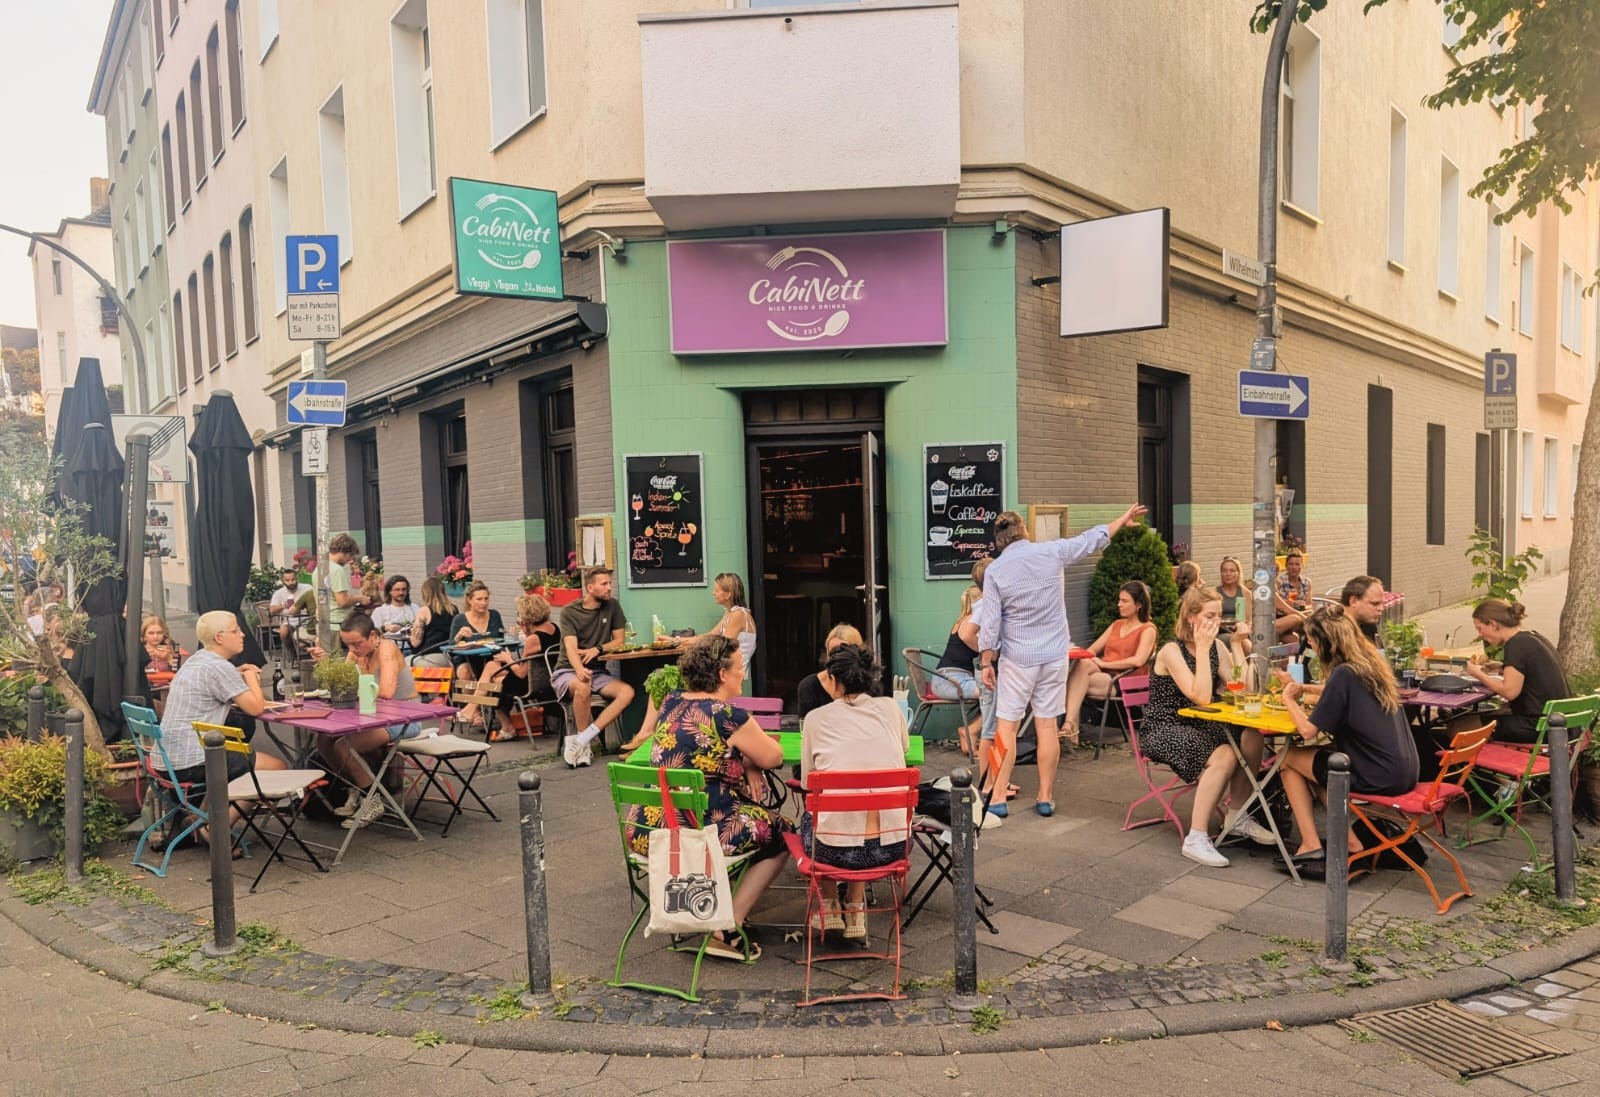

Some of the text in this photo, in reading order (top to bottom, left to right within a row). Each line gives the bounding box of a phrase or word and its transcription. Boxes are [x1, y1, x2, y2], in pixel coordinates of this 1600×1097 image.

[462, 216, 551, 244] CabiNett
[298, 243, 327, 290] P
[466, 276, 490, 290] Veggi
[494, 279, 518, 292] Vegan
[748, 276, 864, 304] CabiNett
[1492, 359, 1510, 392] P
[1243, 388, 1291, 401] Einbahnstraße
